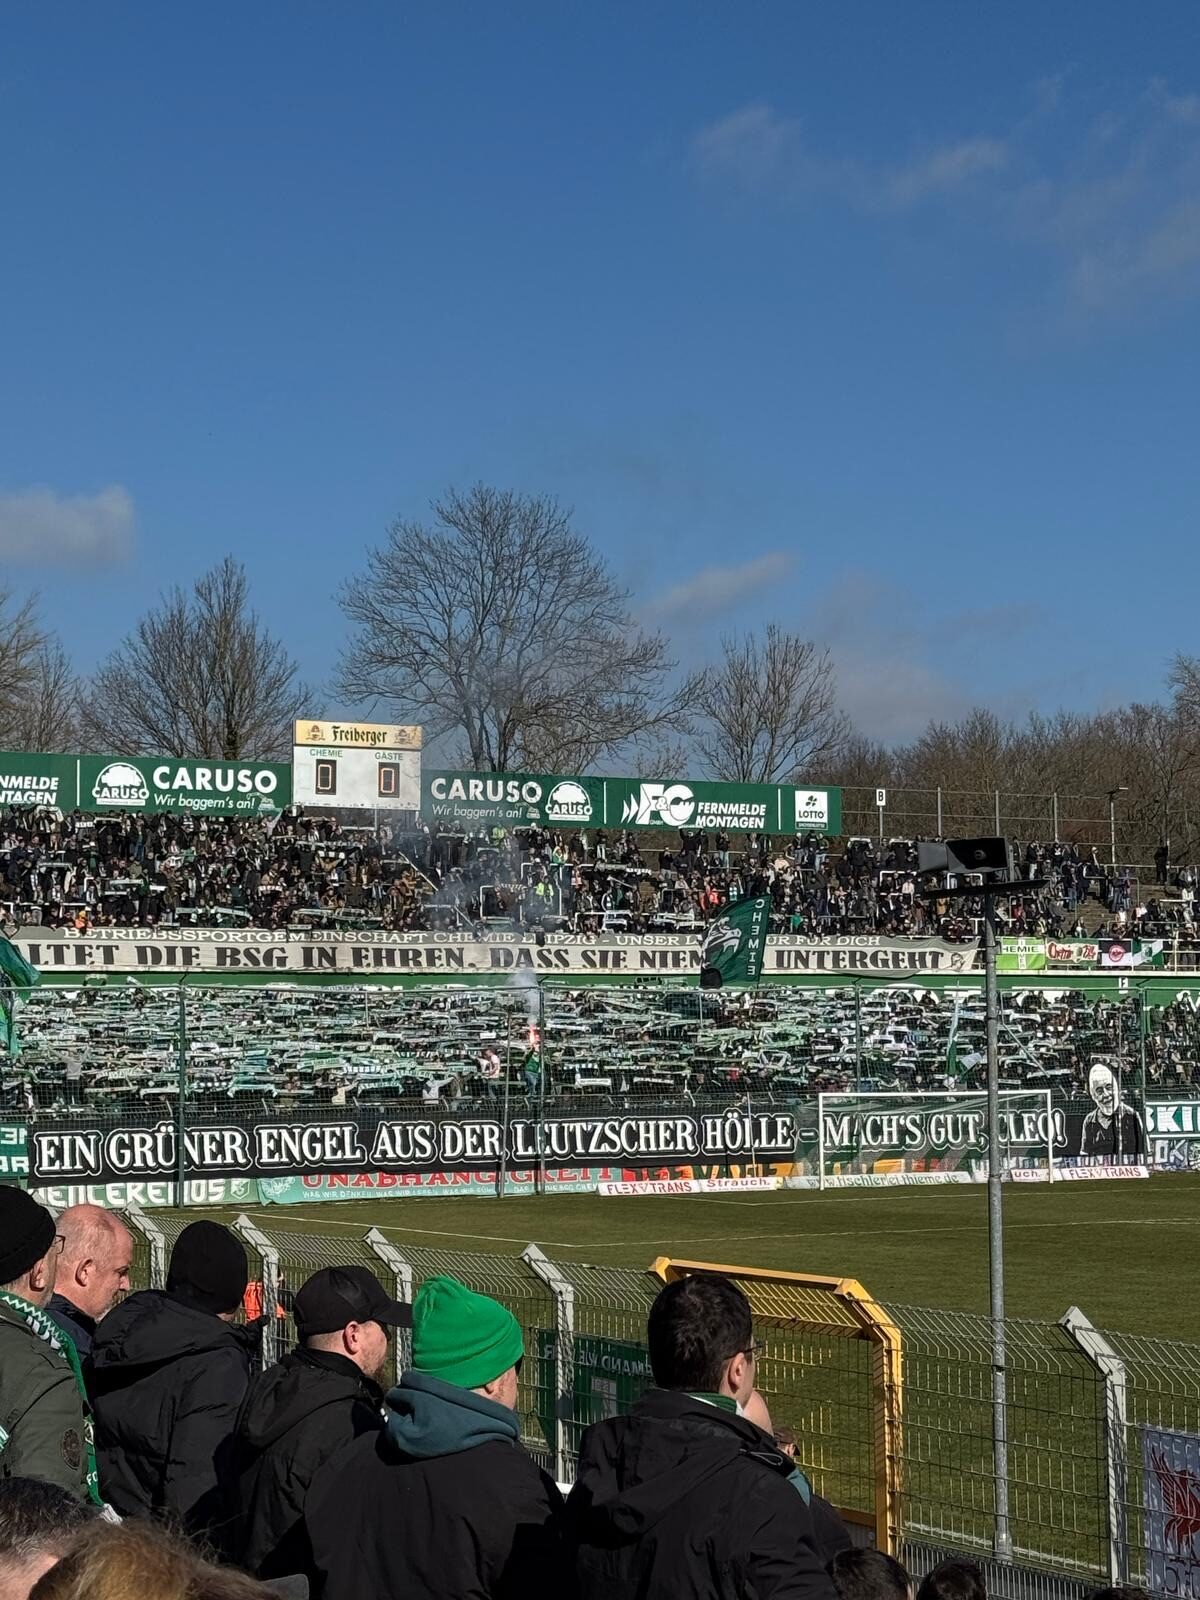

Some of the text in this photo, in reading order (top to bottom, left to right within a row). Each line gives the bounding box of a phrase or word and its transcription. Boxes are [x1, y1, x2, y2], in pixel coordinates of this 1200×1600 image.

[332, 725, 387, 746] Freiberger
[309, 749, 343, 758] CHEMIE
[374, 752, 403, 760] GÄSTE
[153, 765, 277, 794] CARUSO
[318, 764, 332, 790] 0
[380, 767, 394, 793] 0
[92, 786, 149, 800] CARUSO
[431, 778, 542, 804] CARUSO
[878, 791, 884, 801] B
[154, 793, 176, 806] Wir
[236, 798, 255, 809] an!
[432, 804, 451, 816] Wir
[505, 808, 523, 818] an!
[545, 804, 593, 816] CARUSO
[698, 802, 767, 816] FERNMELDE
[798, 811, 825, 819] LOTTO
[696, 815, 765, 829] MONTAGEN
[522, 932, 597, 945] LIPZIG
[616, 935, 676, 946] UNSER
[835, 936, 880, 946] DICH
[14, 944, 119, 966] LTET
[134, 945, 201, 967] DIE
[215, 946, 289, 968] BSG
[301, 946, 338, 967] IN
[489, 947, 571, 968] DASS
[581, 949, 627, 969] SIE
[775, 949, 944, 969] UNTERGEHT
[38, 1135, 97, 1171] EIN
[109, 1125, 247, 1168] GRÜNER
[258, 1126, 361, 1163] ENGEL
[374, 1124, 431, 1159] AUS
[443, 1124, 504, 1157] DER
[514, 1119, 696, 1155] LEUTZSCHER
[704, 1112, 792, 1150] HÖLLE
